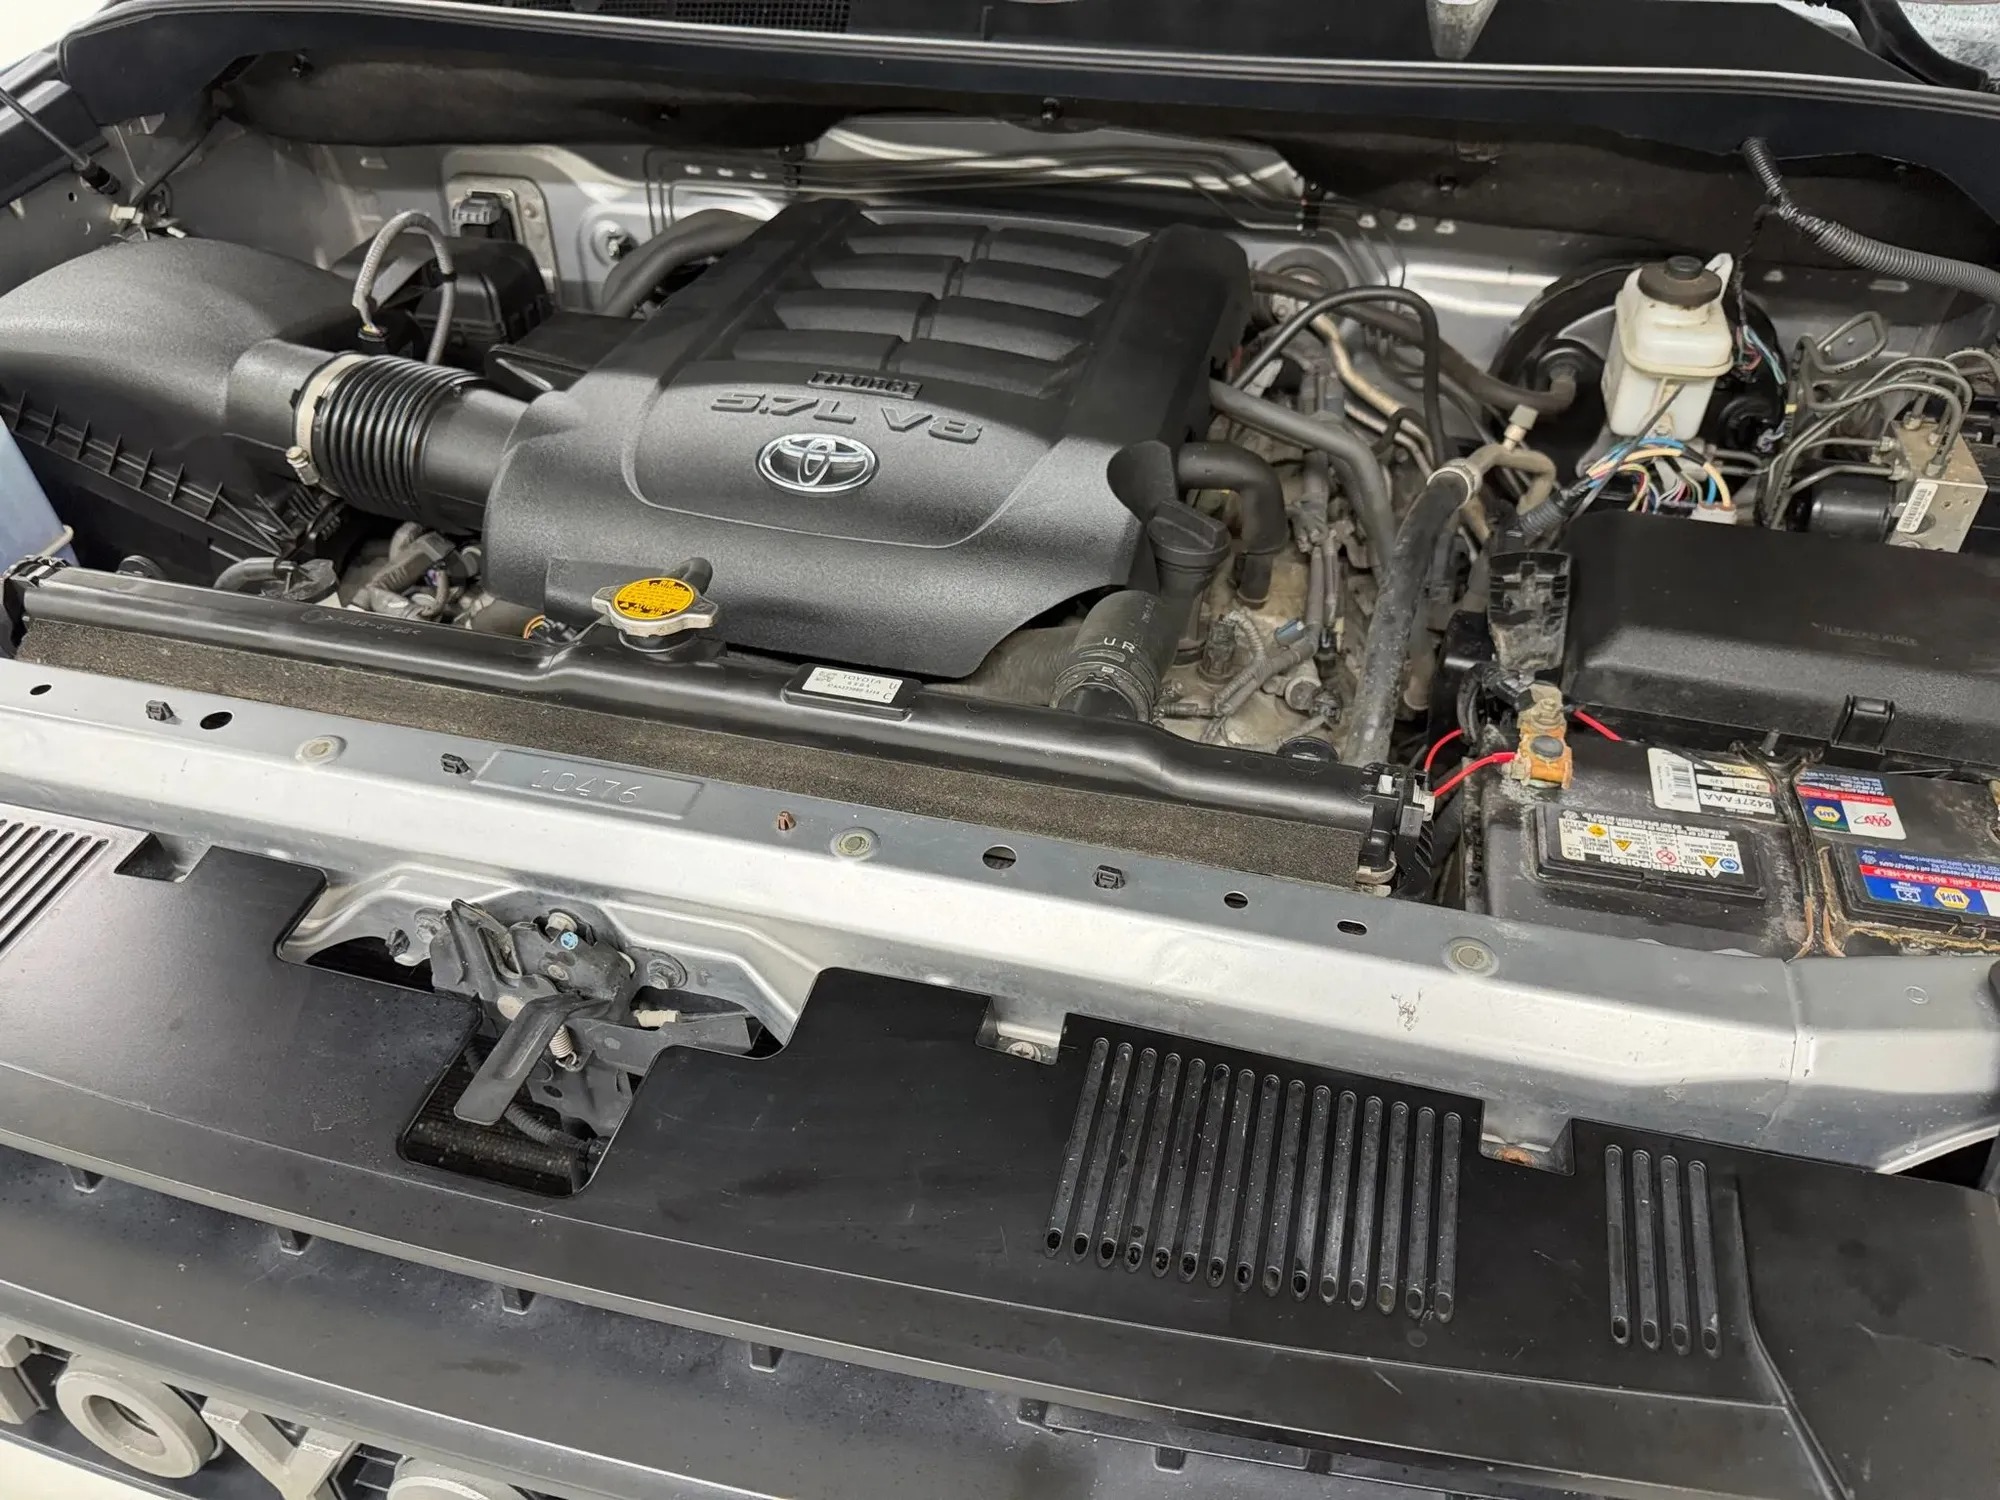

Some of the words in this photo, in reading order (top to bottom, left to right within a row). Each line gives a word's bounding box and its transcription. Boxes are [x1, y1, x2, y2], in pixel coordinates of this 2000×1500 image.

[711, 391, 856, 424] 5.7L
[880, 406, 983, 444] V8
[842, 674, 881, 685] TOYOTA
[1939, 892, 1963, 903] NAPA
